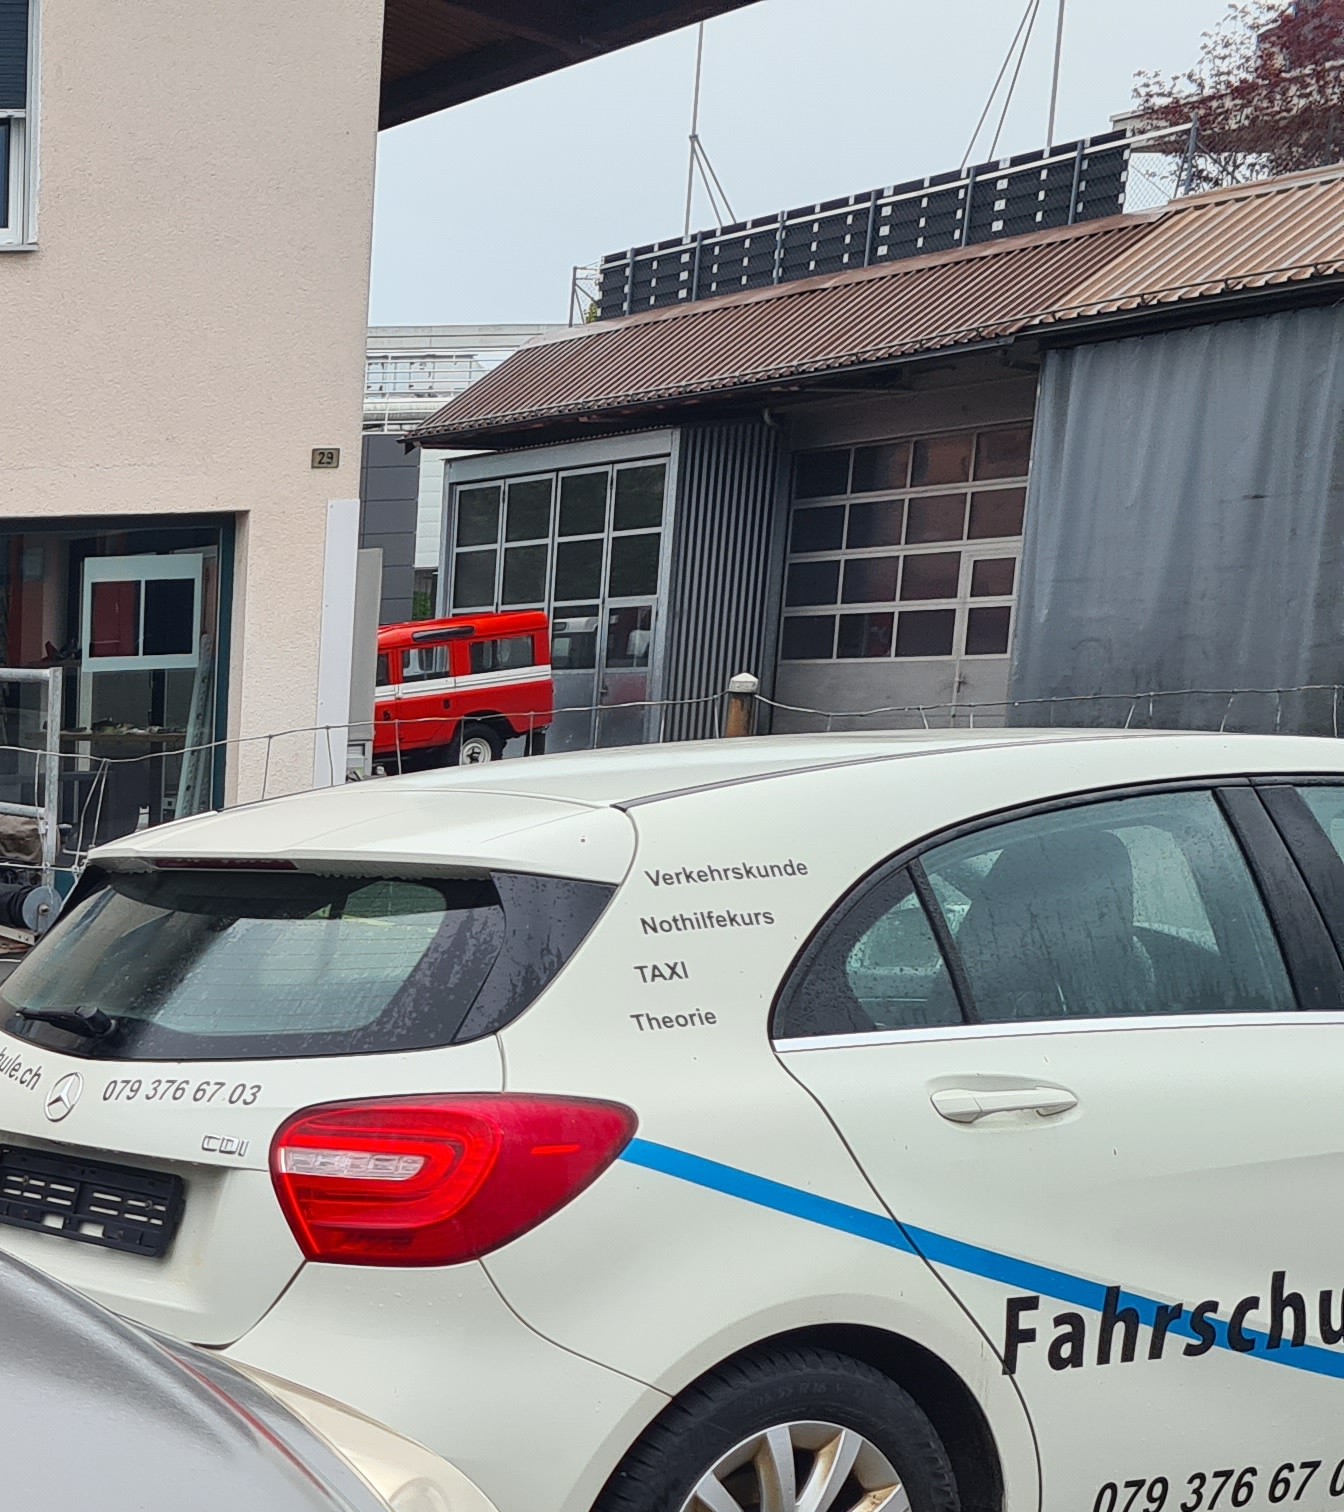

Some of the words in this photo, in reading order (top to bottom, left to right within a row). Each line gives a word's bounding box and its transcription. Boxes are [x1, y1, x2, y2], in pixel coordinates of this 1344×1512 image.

[317, 451, 334, 465] 29
[644, 858, 810, 888] Verkehrskunde
[639, 909, 776, 936] Nothilfekurs
[633, 960, 690, 985] TAXI
[629, 1007, 718, 1033] Theorie
[102, 1078, 143, 1102] 079
[144, 1078, 190, 1101] 376
[192, 1080, 226, 1103] 67
[227, 1082, 262, 1106] 03
[200, 1135, 250, 1158] CDI
[1179, 1466, 1258, 1512] 376
[1267, 1459, 1322, 1504] 67
